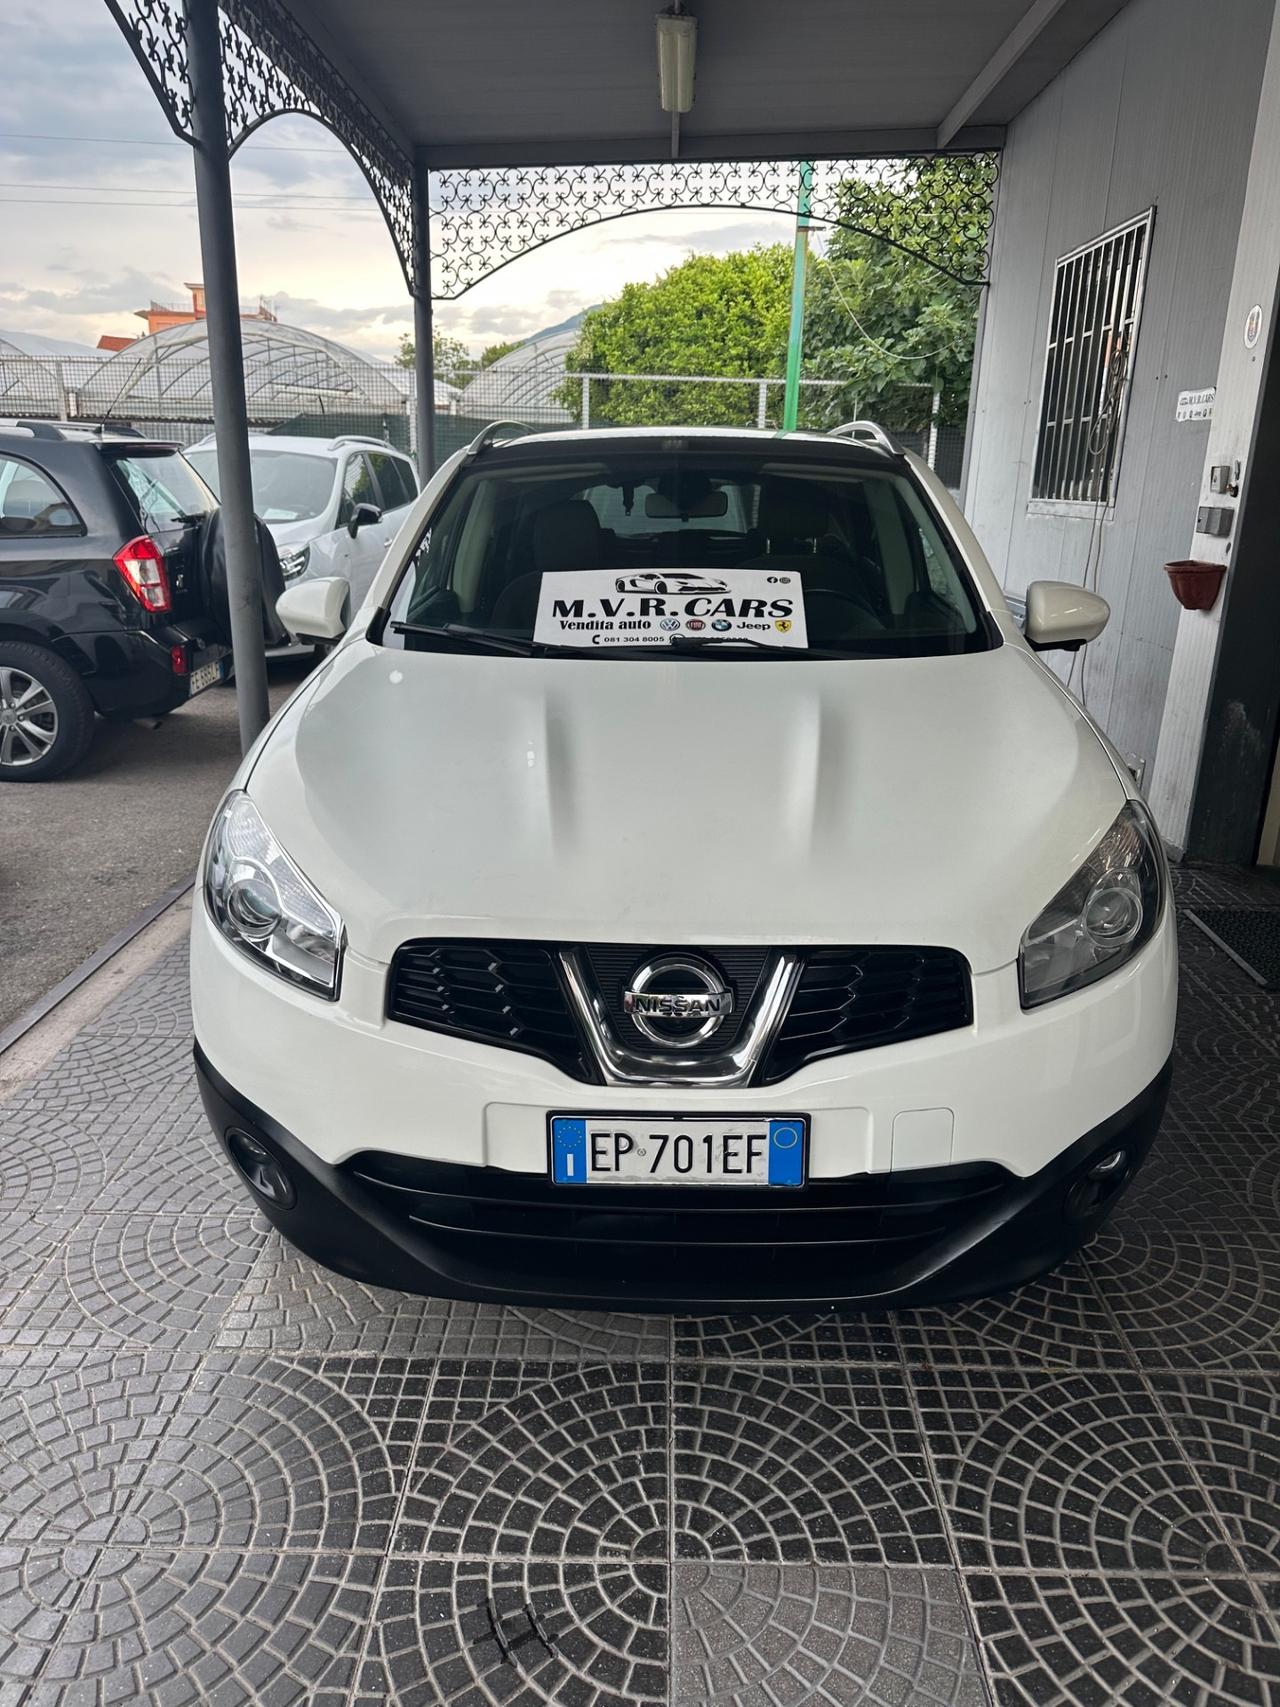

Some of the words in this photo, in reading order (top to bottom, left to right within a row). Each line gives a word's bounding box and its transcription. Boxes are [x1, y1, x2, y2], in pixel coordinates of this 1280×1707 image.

[560, 620, 613, 630] Vendita
[618, 619, 651, 630] auto
[736, 621, 771, 631] Jeep
[636, 998, 720, 1012] NISSAN
[590, 1132, 634, 1172] EP
[649, 1134, 767, 1174] 701EF
